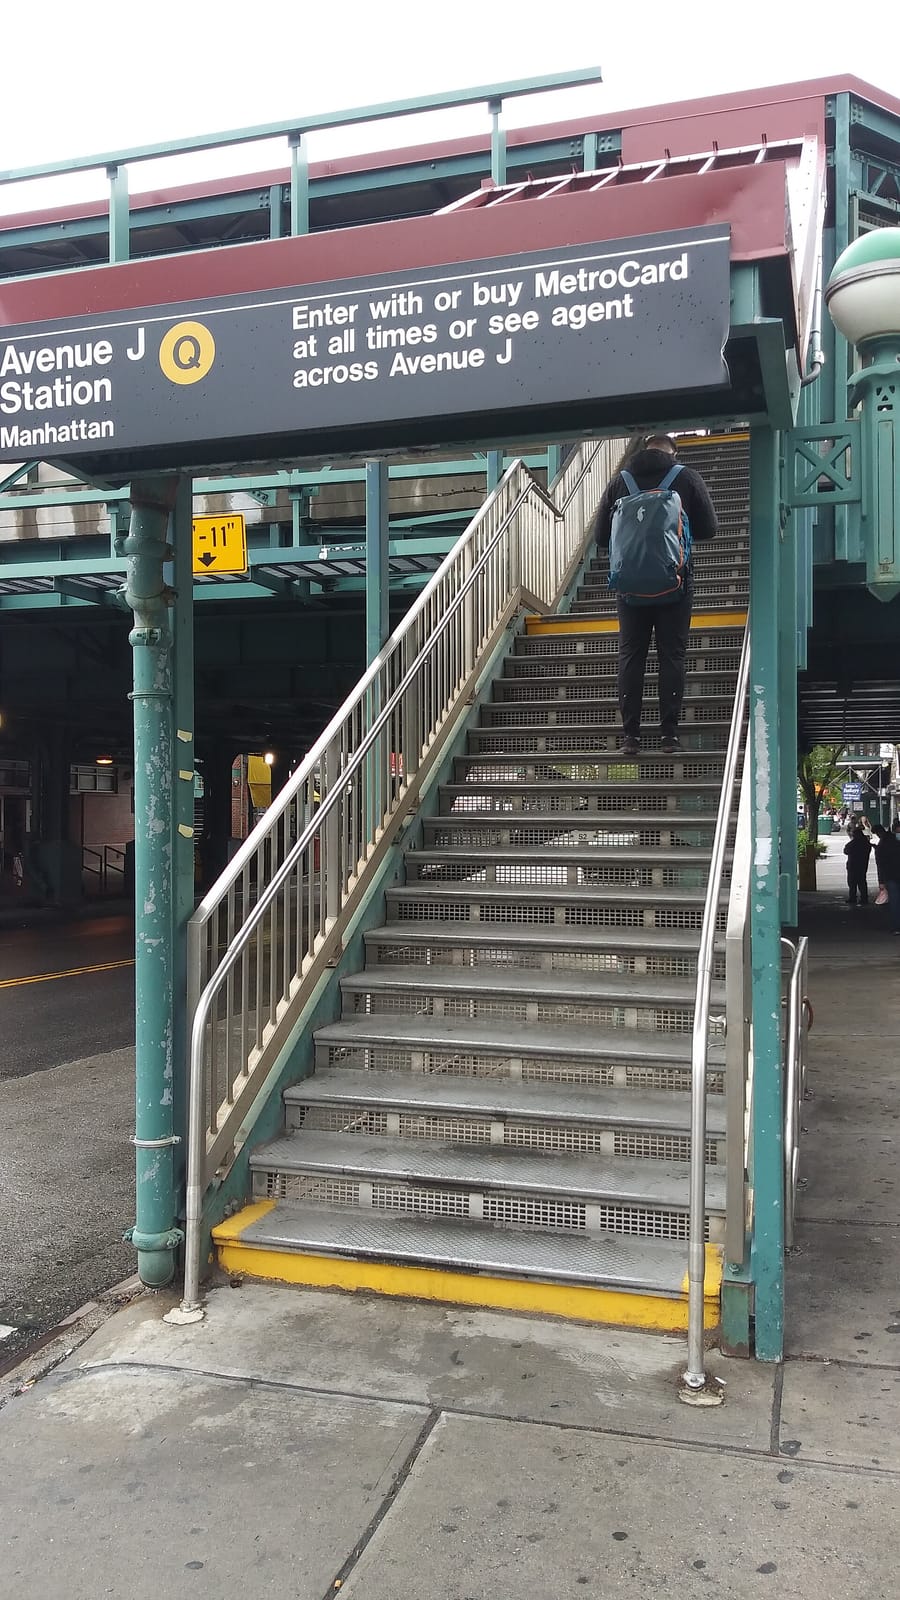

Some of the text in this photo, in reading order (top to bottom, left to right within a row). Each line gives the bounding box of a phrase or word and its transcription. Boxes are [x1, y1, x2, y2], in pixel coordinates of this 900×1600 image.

[292, 253, 690, 330] Enter with or buy MetroCard
[0, 327, 201, 378] Avenue J Q
[292, 294, 634, 360] at all times or see agent
[292, 337, 513, 389] across Avenue J
[0, 375, 112, 414] Station
[0, 418, 115, 448] Manhattan
